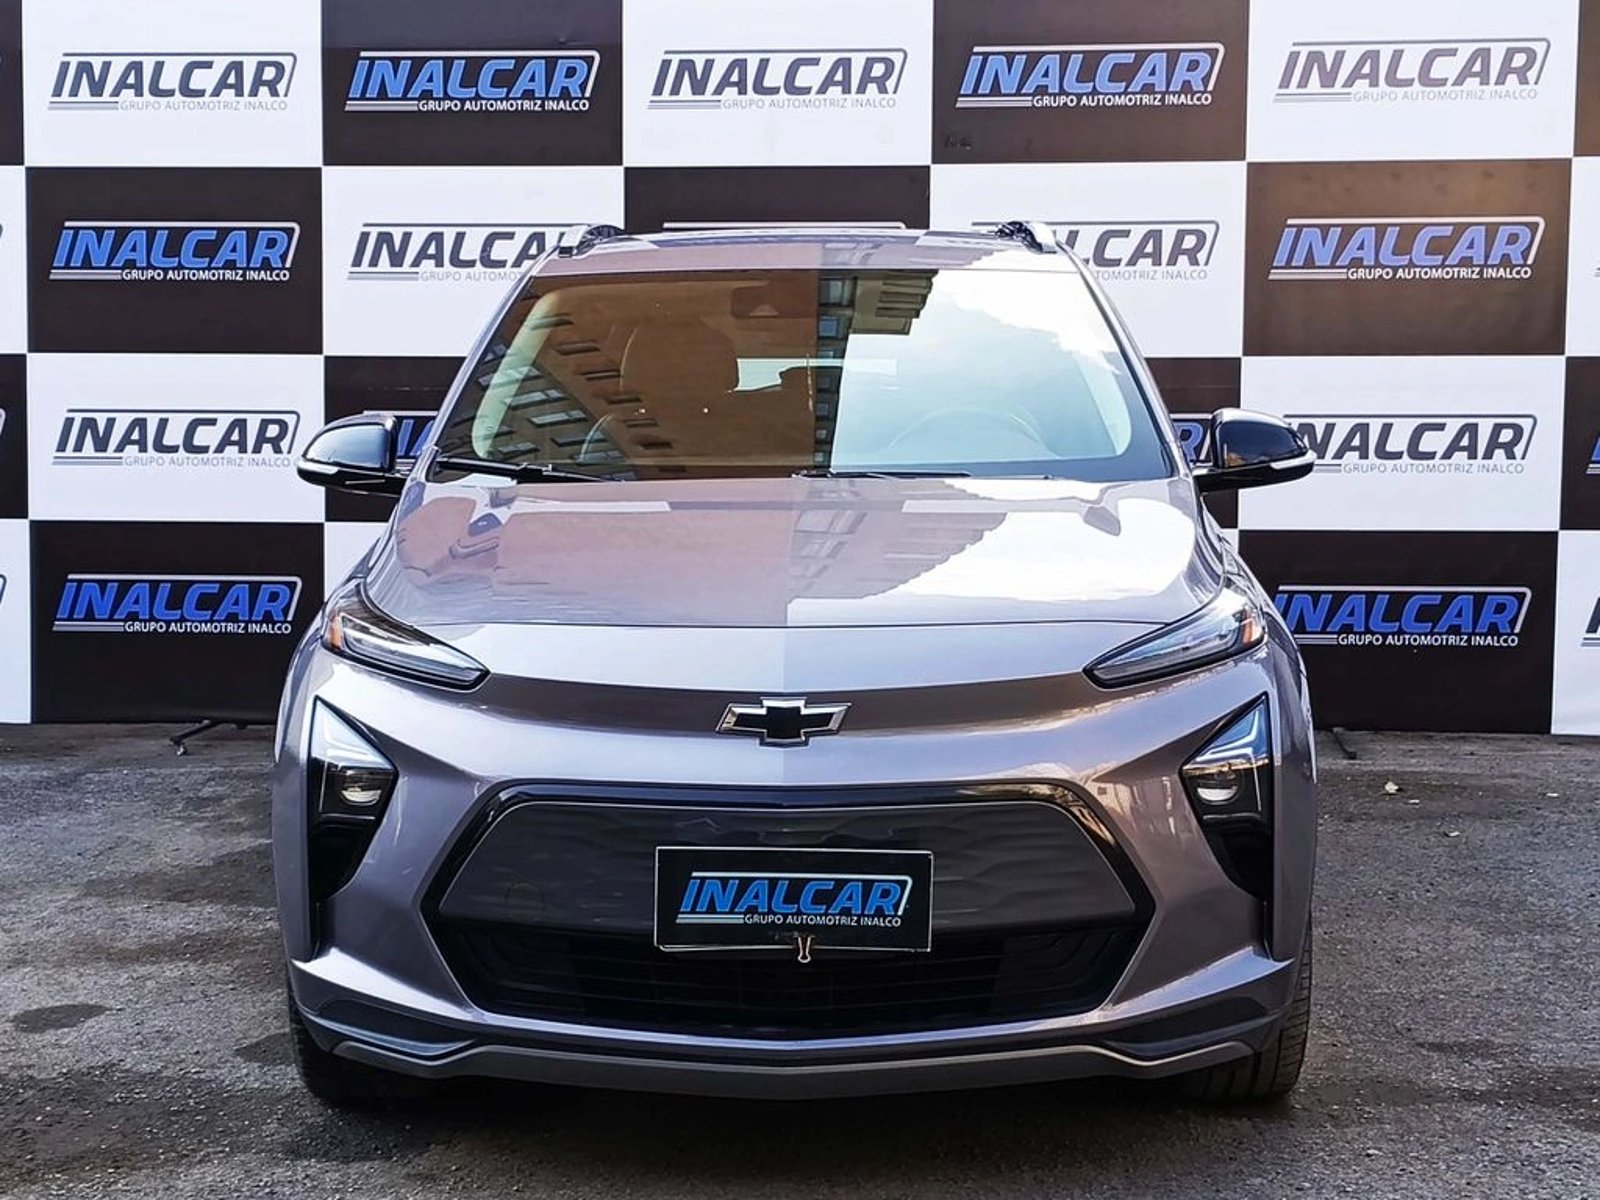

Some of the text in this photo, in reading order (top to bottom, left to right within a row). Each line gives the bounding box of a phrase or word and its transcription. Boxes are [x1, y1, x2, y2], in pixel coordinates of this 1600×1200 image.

[960, 52, 1212, 94] INALCAR
[1277, 47, 1537, 89] INALCAR
[51, 60, 285, 98] INALCAR
[347, 59, 588, 98] INALCAR
[651, 57, 895, 96] INALCAR
[1033, 94, 1212, 107] GRUPO AUTOMOTRIZ INALCO
[1352, 89, 1538, 103] GRUPO AUTOMOTRIZ INALCO
[120, 100, 288, 111] GRUPO AUTOMOTRIZ INALCO
[419, 100, 589, 111] GRUPO AUTOMOTRIZ INALCO
[722, 98, 896, 110] GRUPO AUTOMOTRIZ INALCO
[52, 229, 288, 268] INALCAR
[350, 231, 566, 268] INALCA
[1272, 225, 1532, 267] INALCAR
[122, 270, 290, 281] GRUPO AUTOMOTRIZ INALCO
[421, 271, 462, 281] GRUPO
[1162, 269, 1208, 281] INALCO
[1348, 267, 1532, 280] GRUPO AUTOMOTRIZ INALCO
[55, 417, 289, 454] INALCAR
[1289, 422, 1524, 461] NALCAR
[124, 456, 291, 468] GRUPO AUTOMOTRIZ INALCO
[1343, 463, 1524, 474] GRUPO AUTOMOTRIZ INALCO
[56, 582, 290, 621] INALCAR
[124, 621, 292, 634] GRUPO AUTOMOTRIZ INALCO
[1338, 634, 1519, 647] GRUPO AUTOMOTRIZ INALCO
[680, 879, 901, 916] INALCAR
[745, 914, 902, 927] GRUPO AUTOMOTRIZ INALCO
